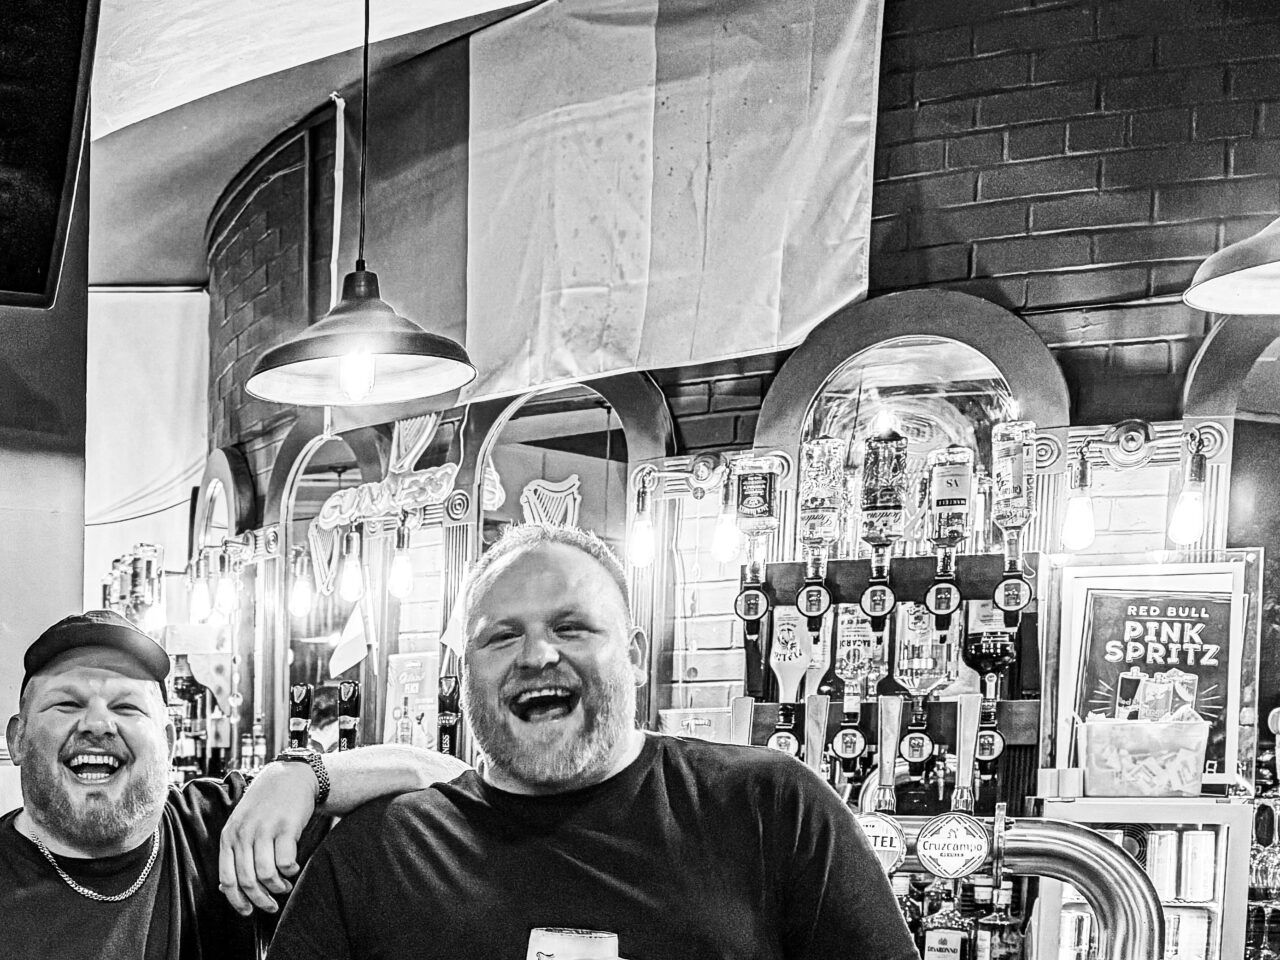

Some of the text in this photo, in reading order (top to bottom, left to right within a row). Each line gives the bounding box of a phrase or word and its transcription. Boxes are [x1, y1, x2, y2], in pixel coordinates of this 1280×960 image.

[1127, 605, 1209, 618] RED BULL
[1124, 620, 1206, 644] PINK
[1105, 640, 1221, 666] SPRITZ
[922, 840, 983, 853] Cruzcampo
